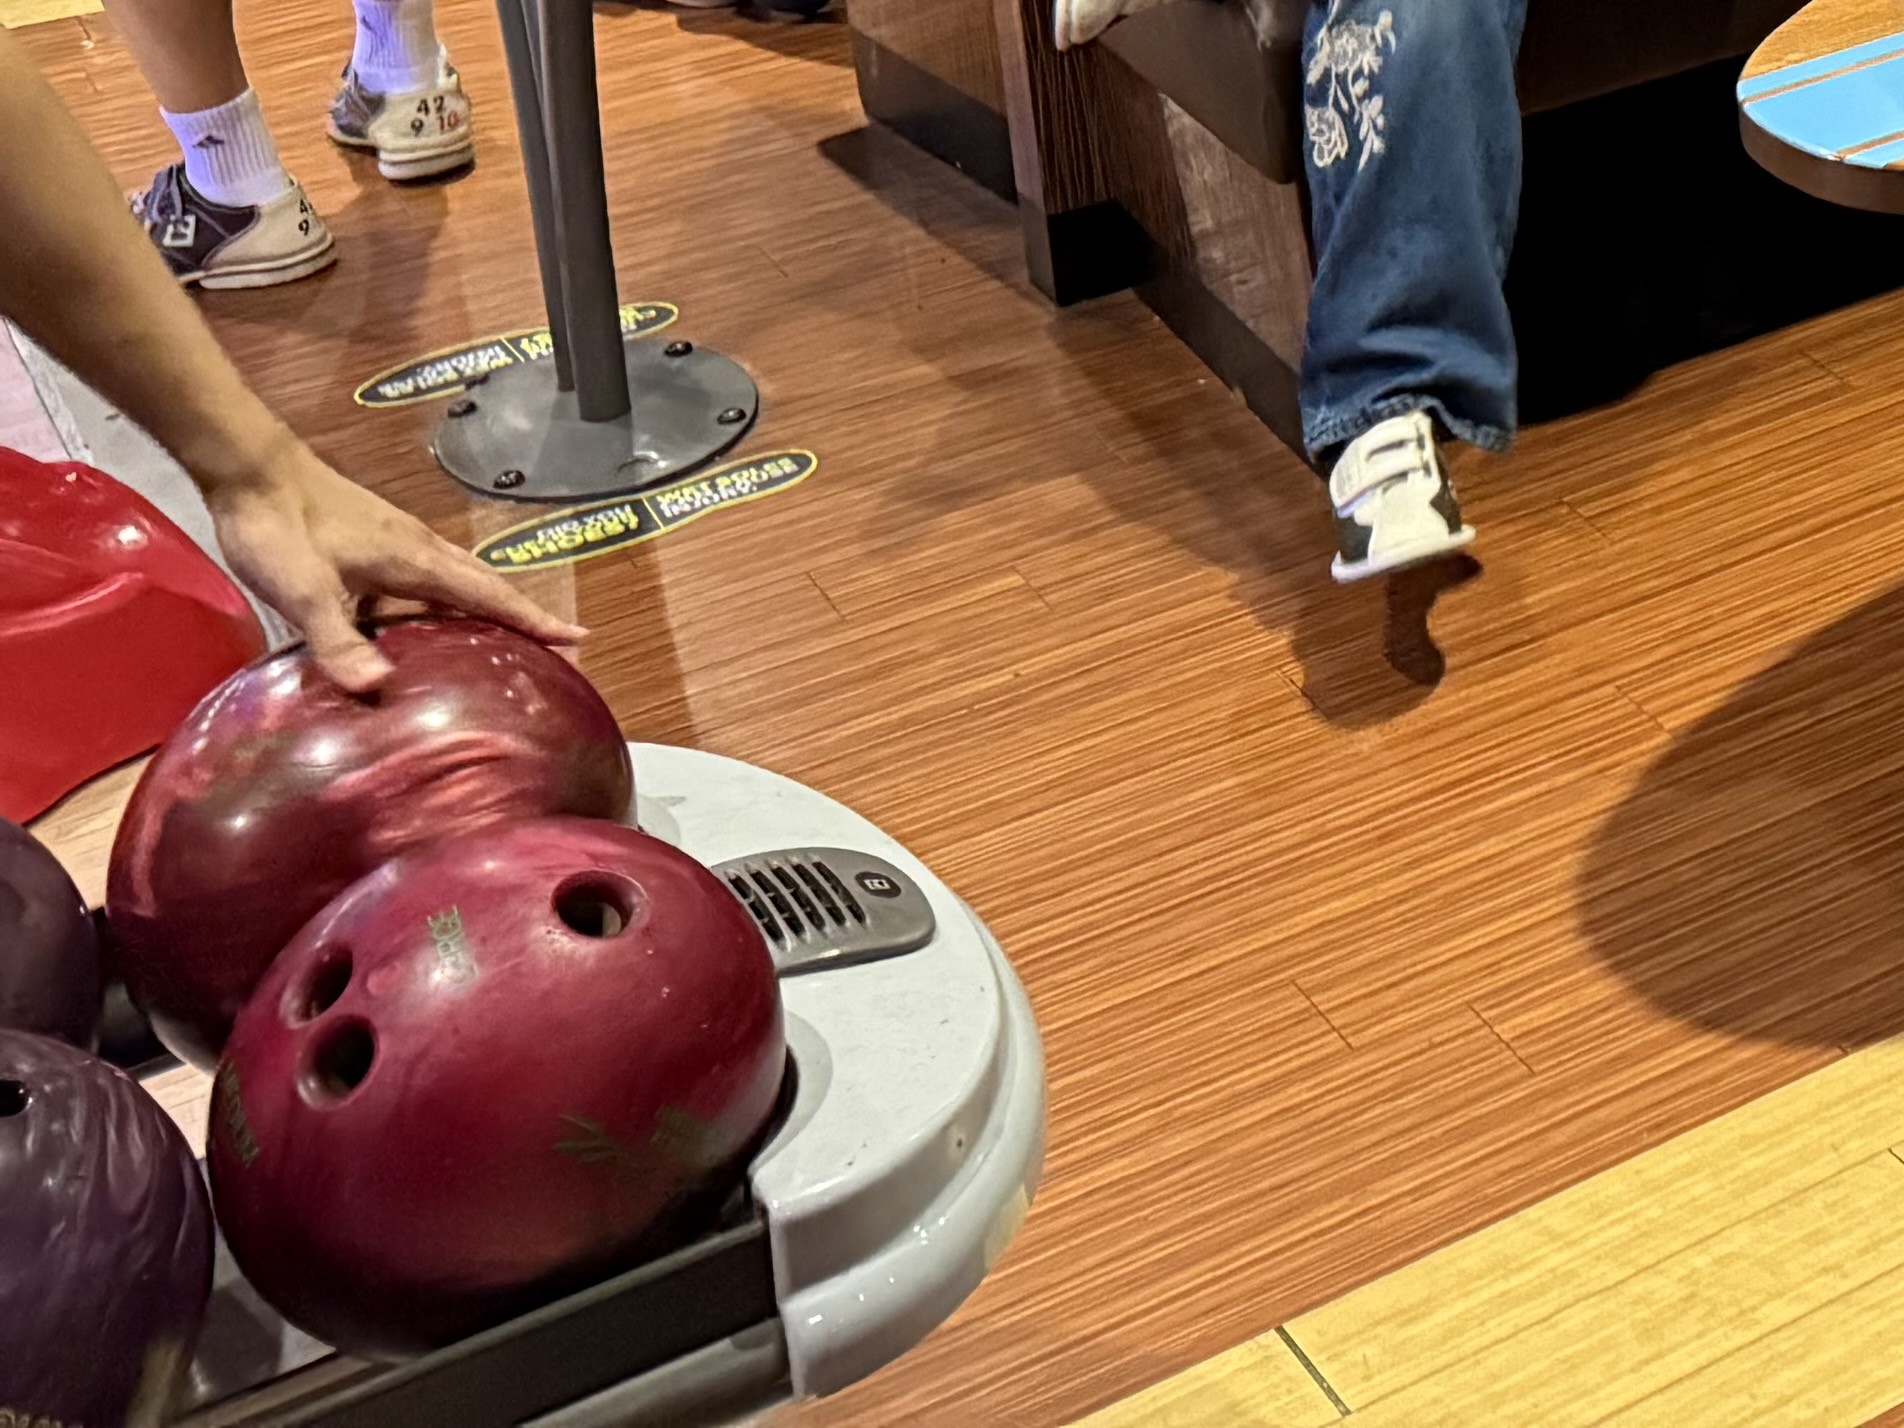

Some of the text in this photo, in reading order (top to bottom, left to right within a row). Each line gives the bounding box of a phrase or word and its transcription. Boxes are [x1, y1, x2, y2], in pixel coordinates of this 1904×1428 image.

[417, 95, 447, 116] 42
[411, 118, 424, 137] 9
[298, 219, 310, 237] 9
